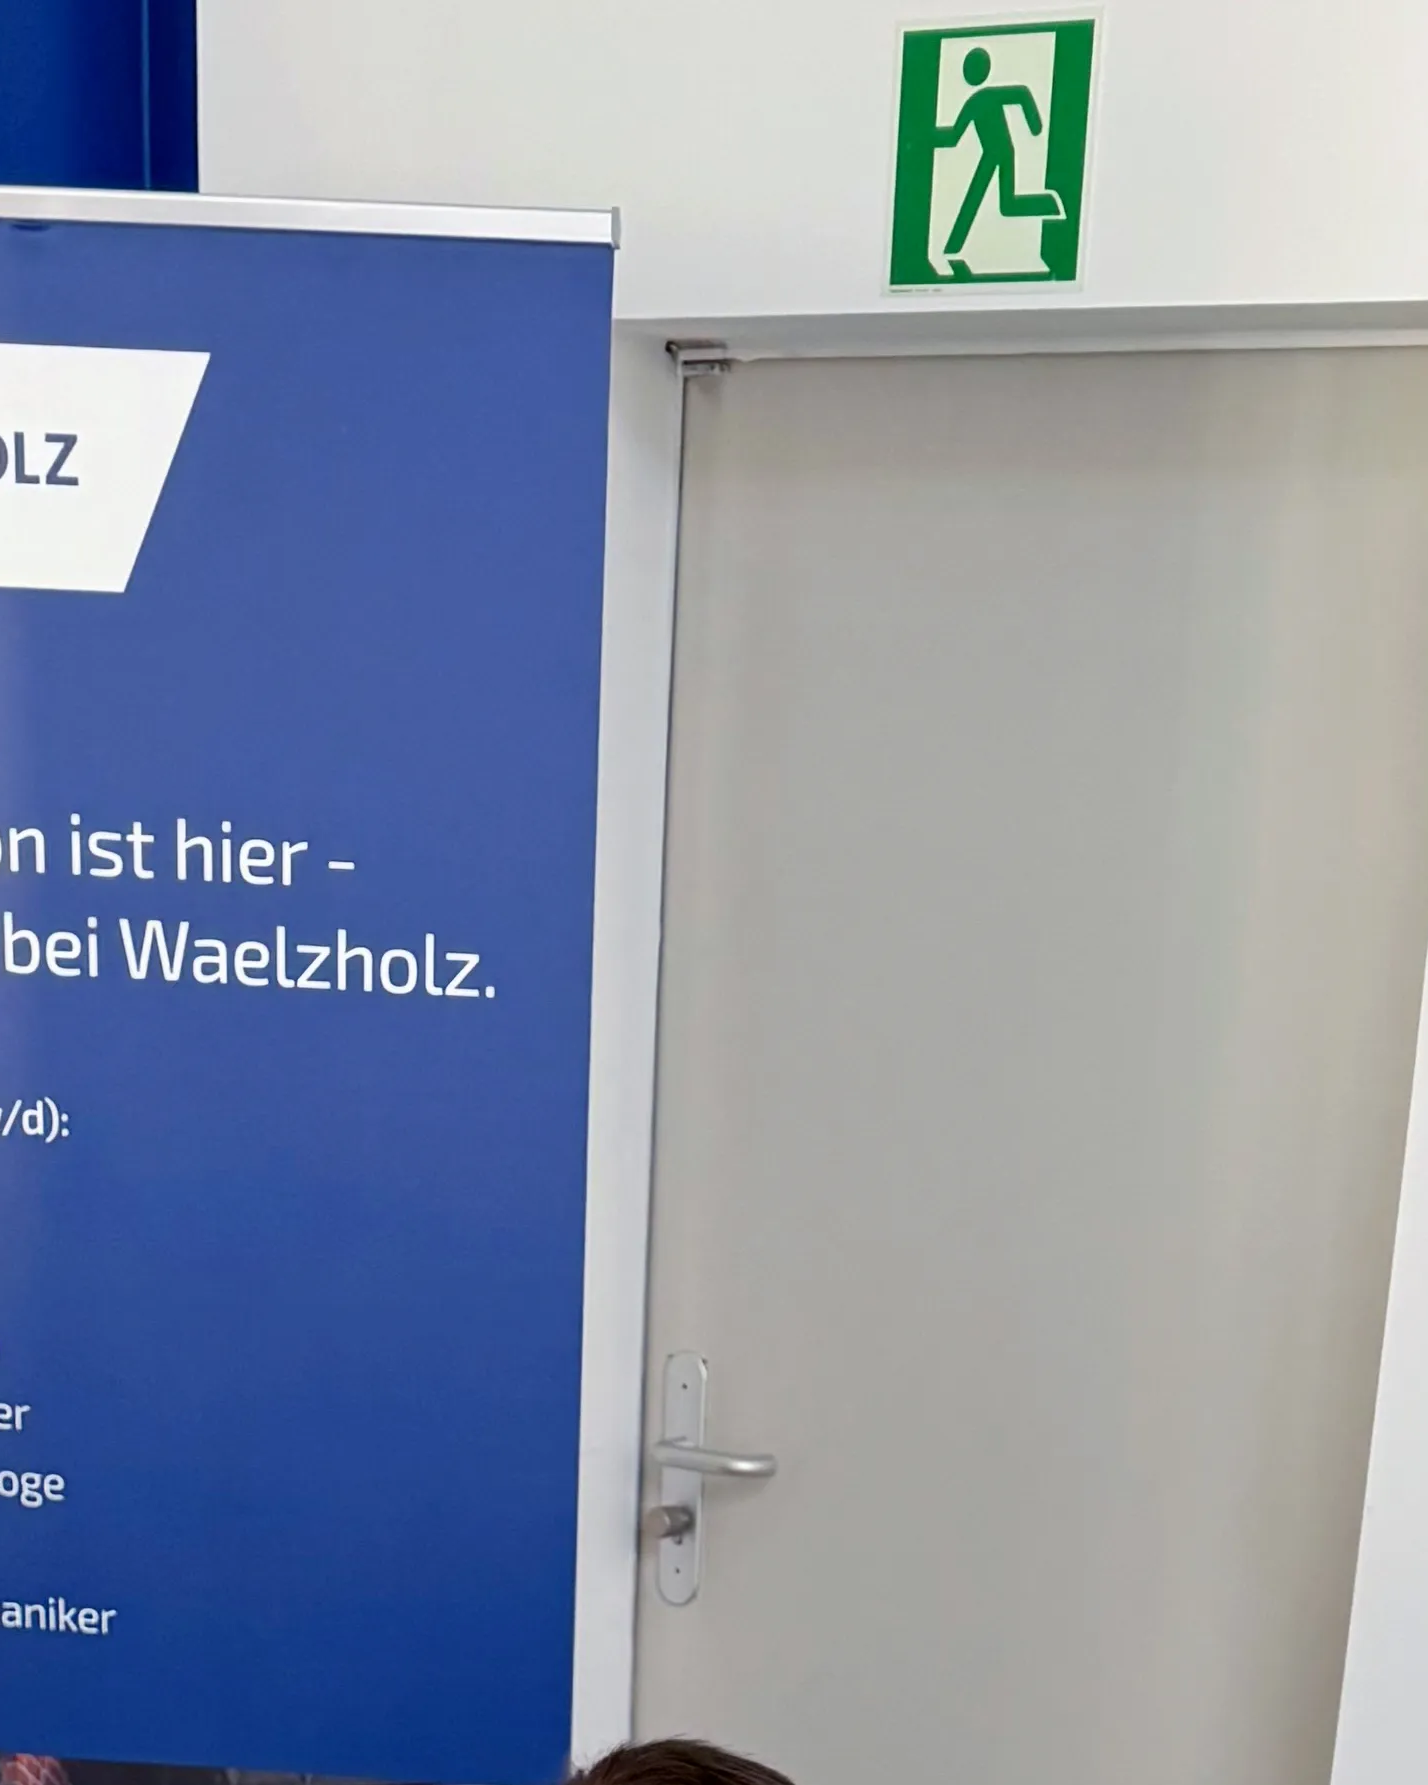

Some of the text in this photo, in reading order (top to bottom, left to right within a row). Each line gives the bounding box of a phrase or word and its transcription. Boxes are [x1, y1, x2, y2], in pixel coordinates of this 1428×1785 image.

[71, 814, 154, 879] ist
[177, 818, 308, 885] hier
[4, 912, 98, 977] bei
[119, 919, 495, 998] Waelzholz.
